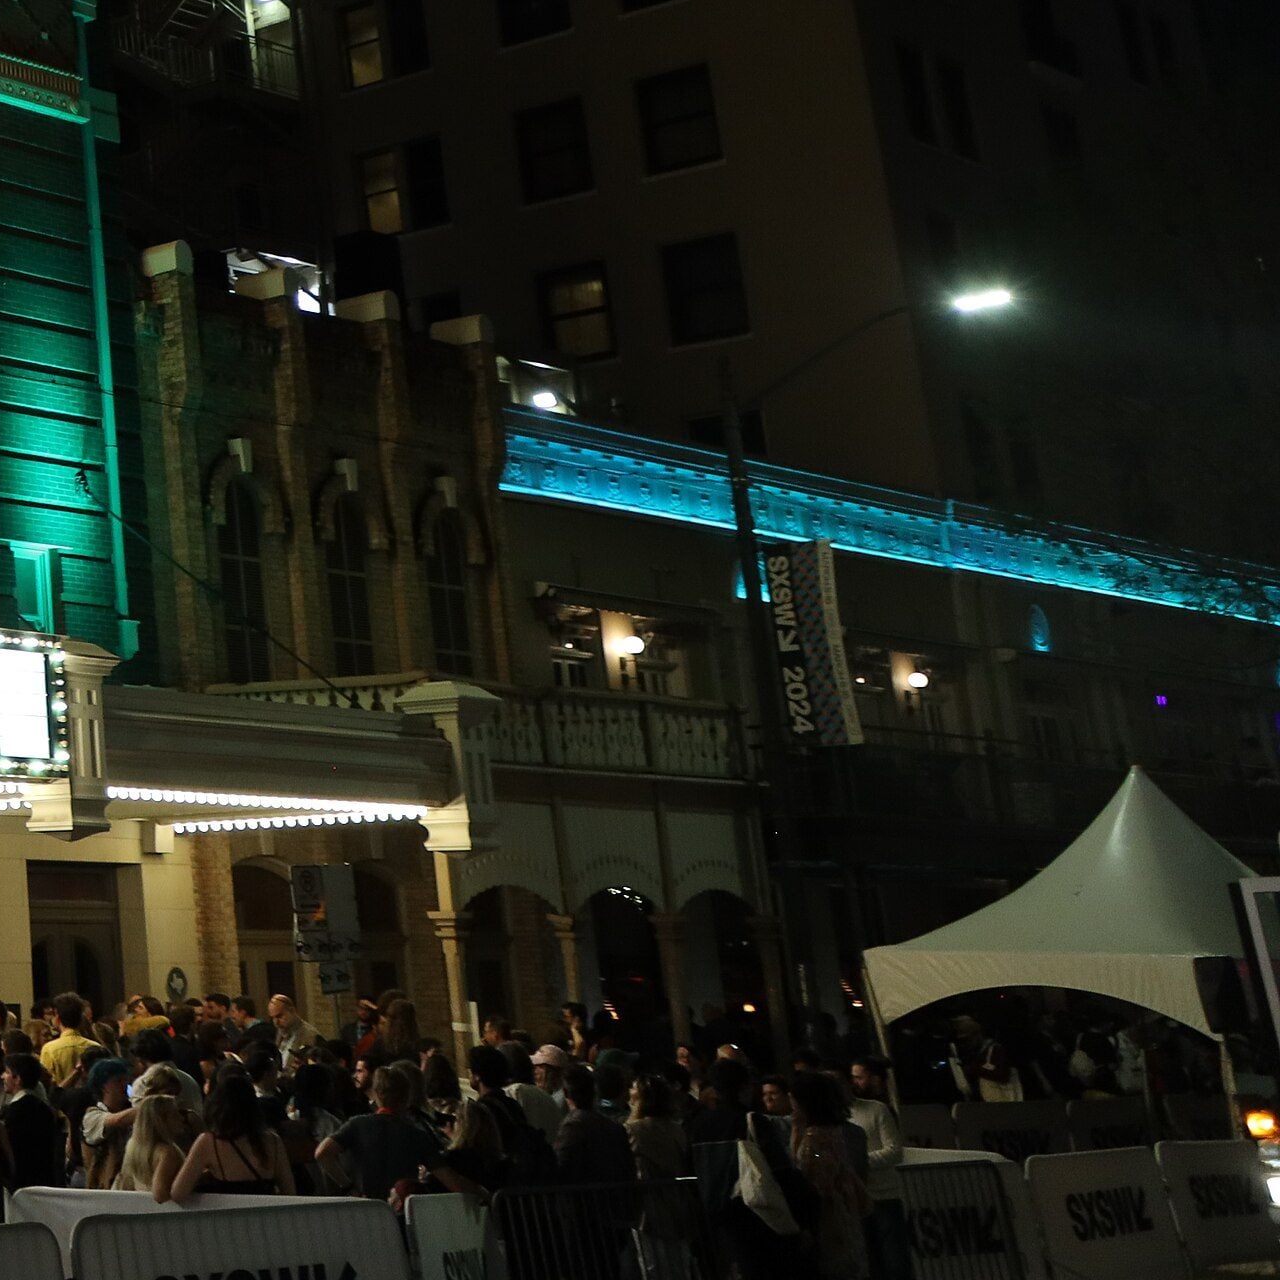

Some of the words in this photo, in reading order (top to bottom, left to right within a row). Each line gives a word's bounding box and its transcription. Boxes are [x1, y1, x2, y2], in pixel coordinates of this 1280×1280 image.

[767, 555, 798, 626] SXSW
[783, 665, 815, 735] 2024
[1065, 1186, 1133, 1242] SXSW
